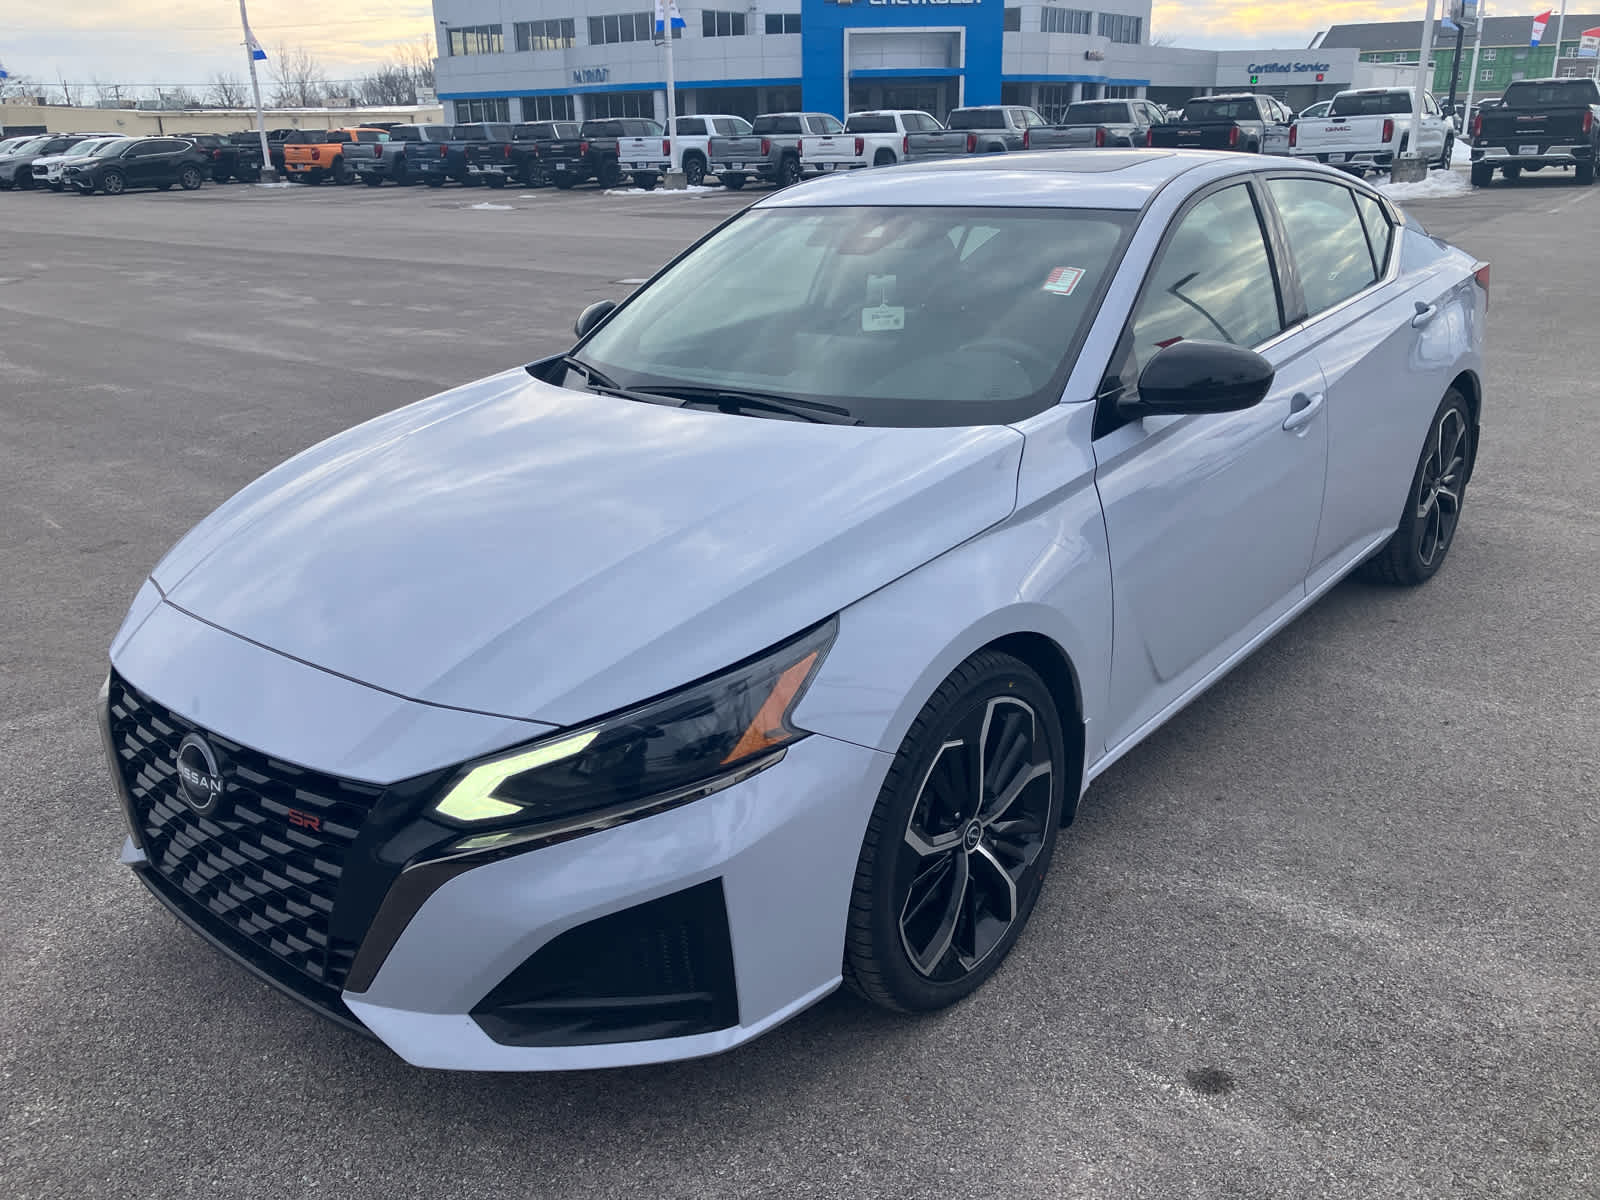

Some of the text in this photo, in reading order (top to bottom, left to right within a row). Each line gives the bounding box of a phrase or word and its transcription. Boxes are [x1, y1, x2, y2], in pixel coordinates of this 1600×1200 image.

[1247, 62, 1330, 74] Certified Service
[288, 808, 321, 832] SR
